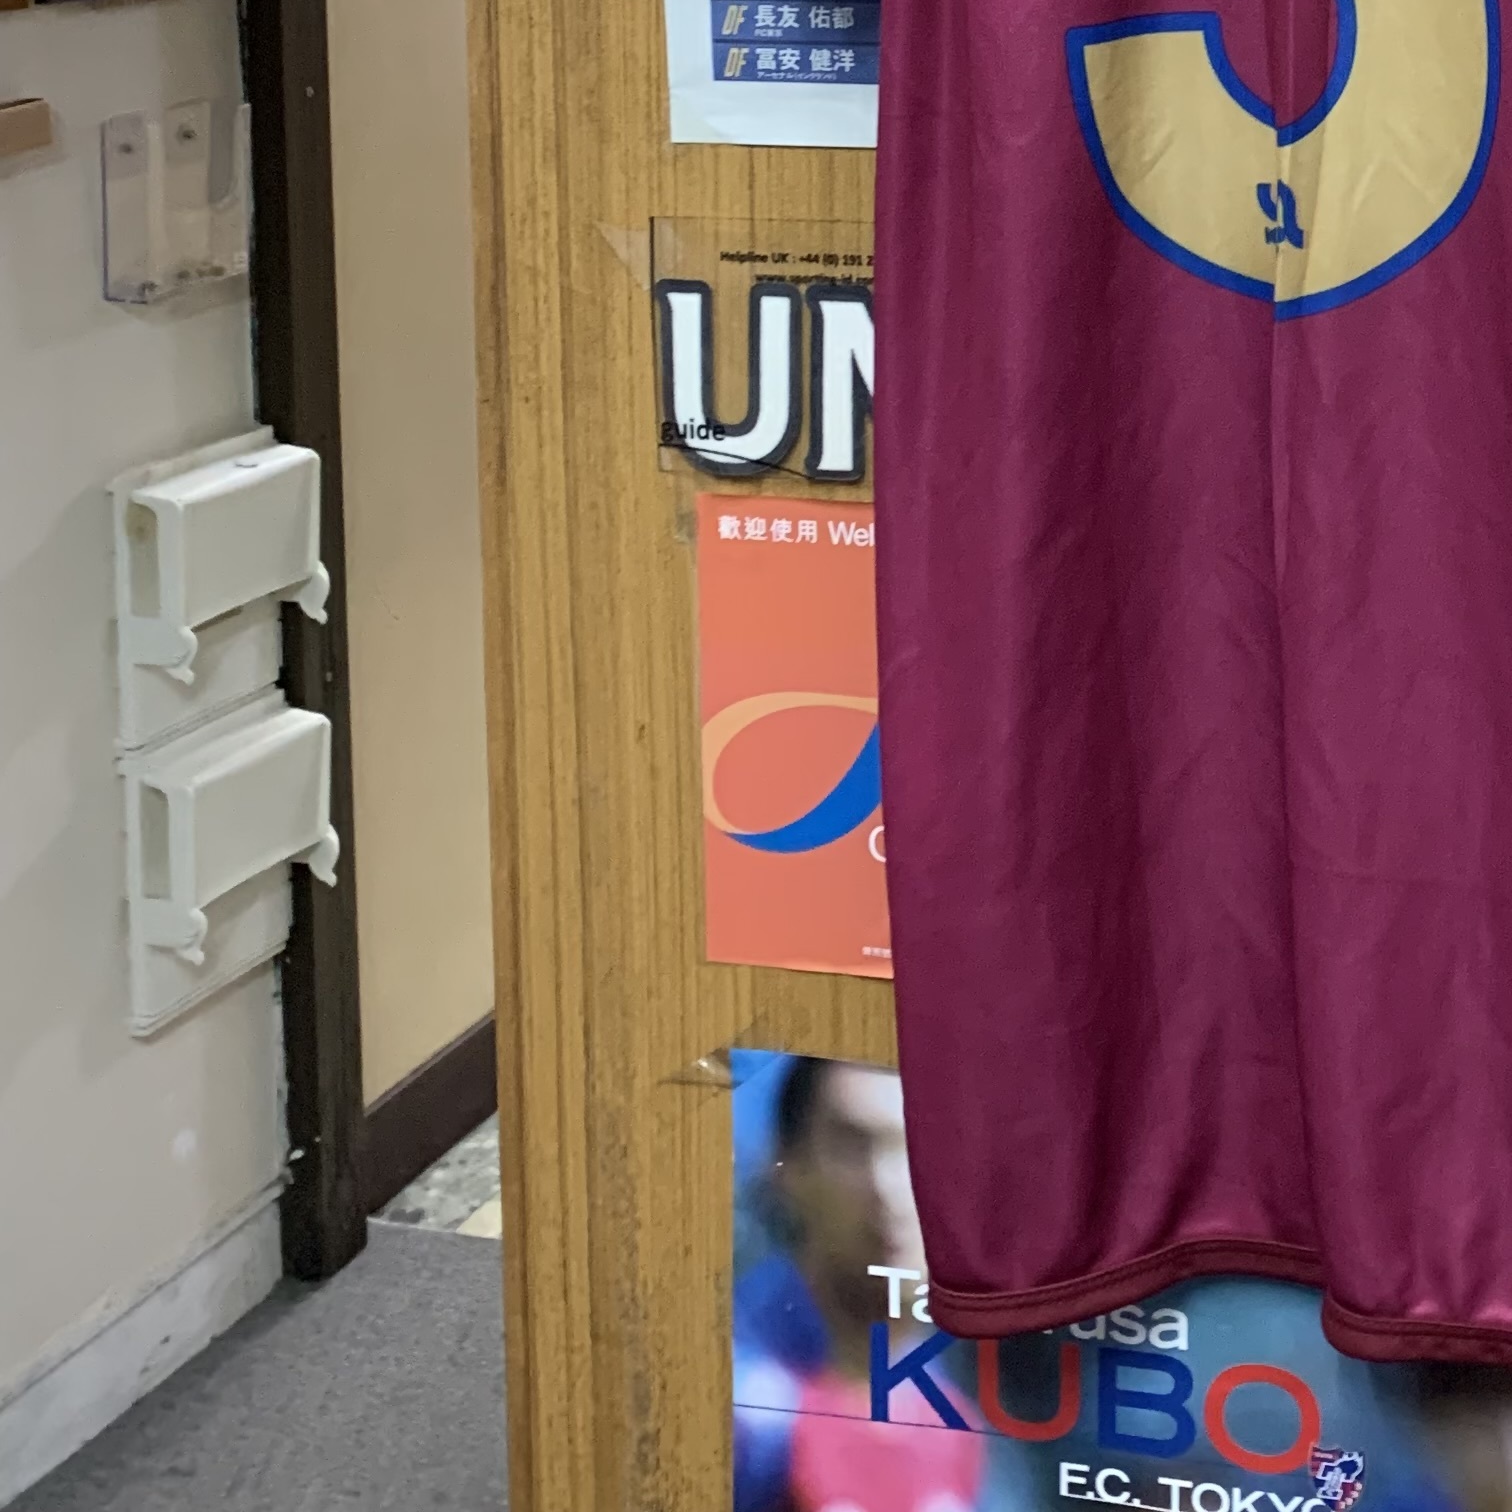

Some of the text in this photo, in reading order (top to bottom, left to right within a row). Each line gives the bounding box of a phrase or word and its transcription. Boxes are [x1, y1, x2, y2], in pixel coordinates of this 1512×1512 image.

[721, 5, 854, 35] DF 長友 佑都
[724, 47, 749, 77] DF
[809, 48, 855, 72] 健洋
[870, 1321, 1321, 1475] KUBO
